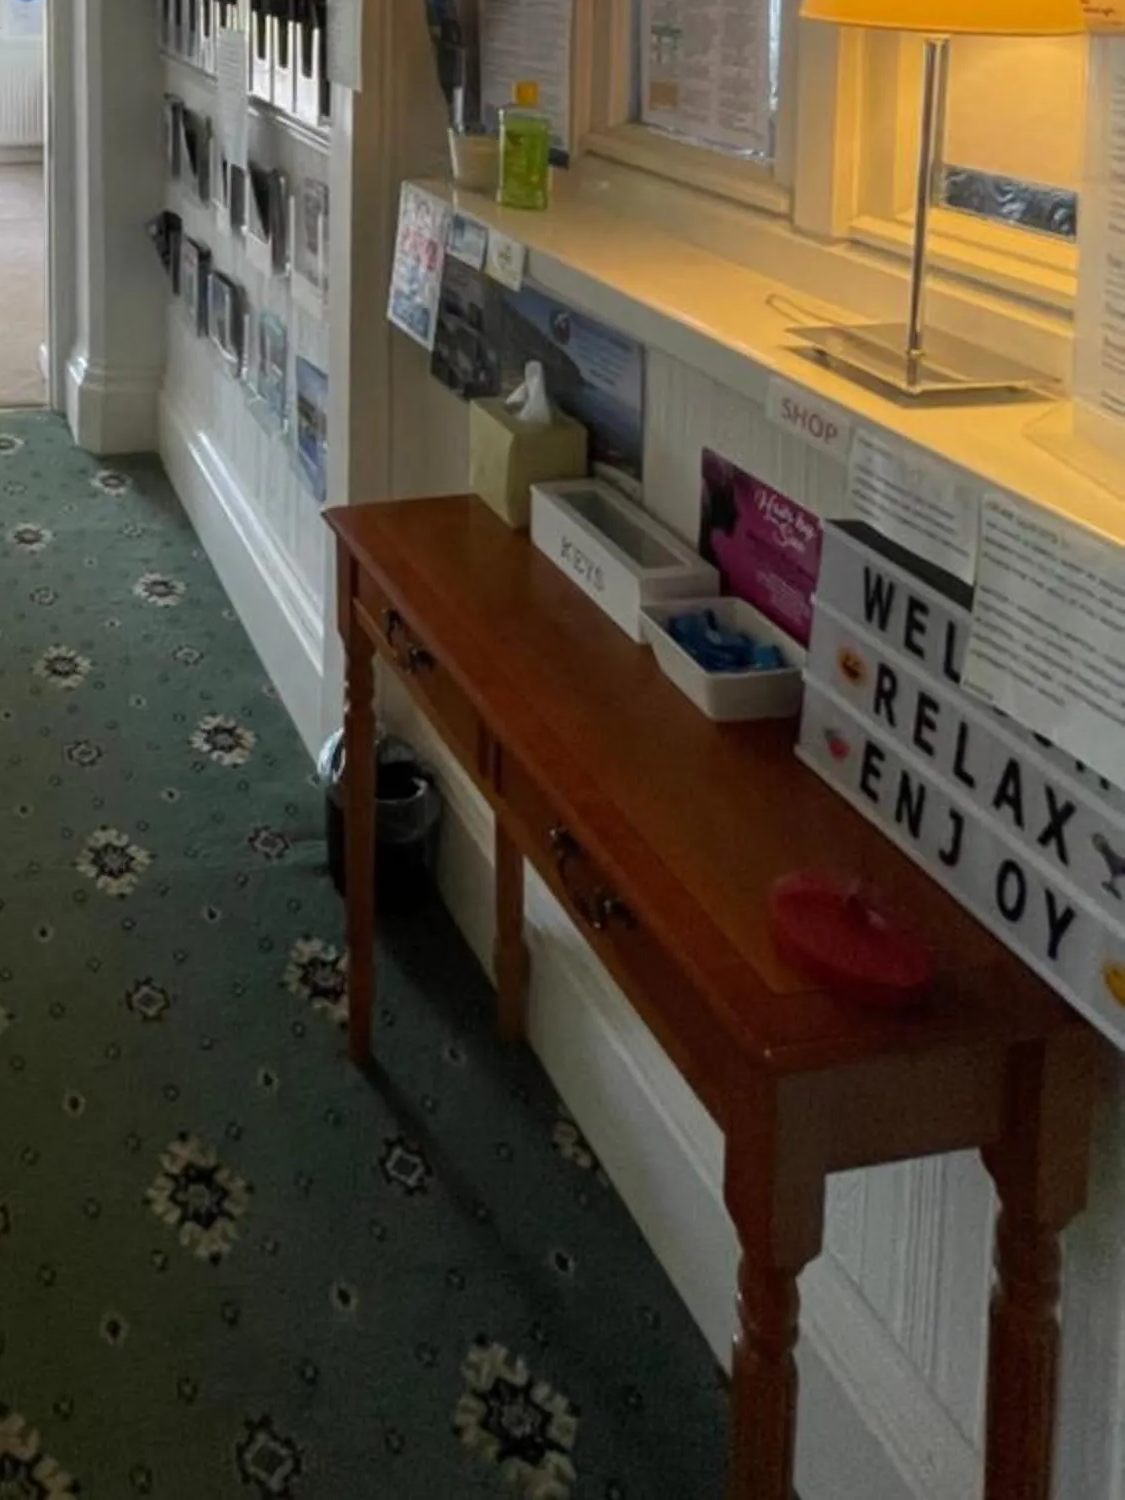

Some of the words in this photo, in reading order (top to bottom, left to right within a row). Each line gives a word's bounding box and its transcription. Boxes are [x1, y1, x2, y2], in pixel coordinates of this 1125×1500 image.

[782, 397, 838, 444] SHOP
[560, 536, 605, 592] KEYS
[874, 661, 1077, 866] RELAX
[860, 740, 1076, 961] ENJOY
